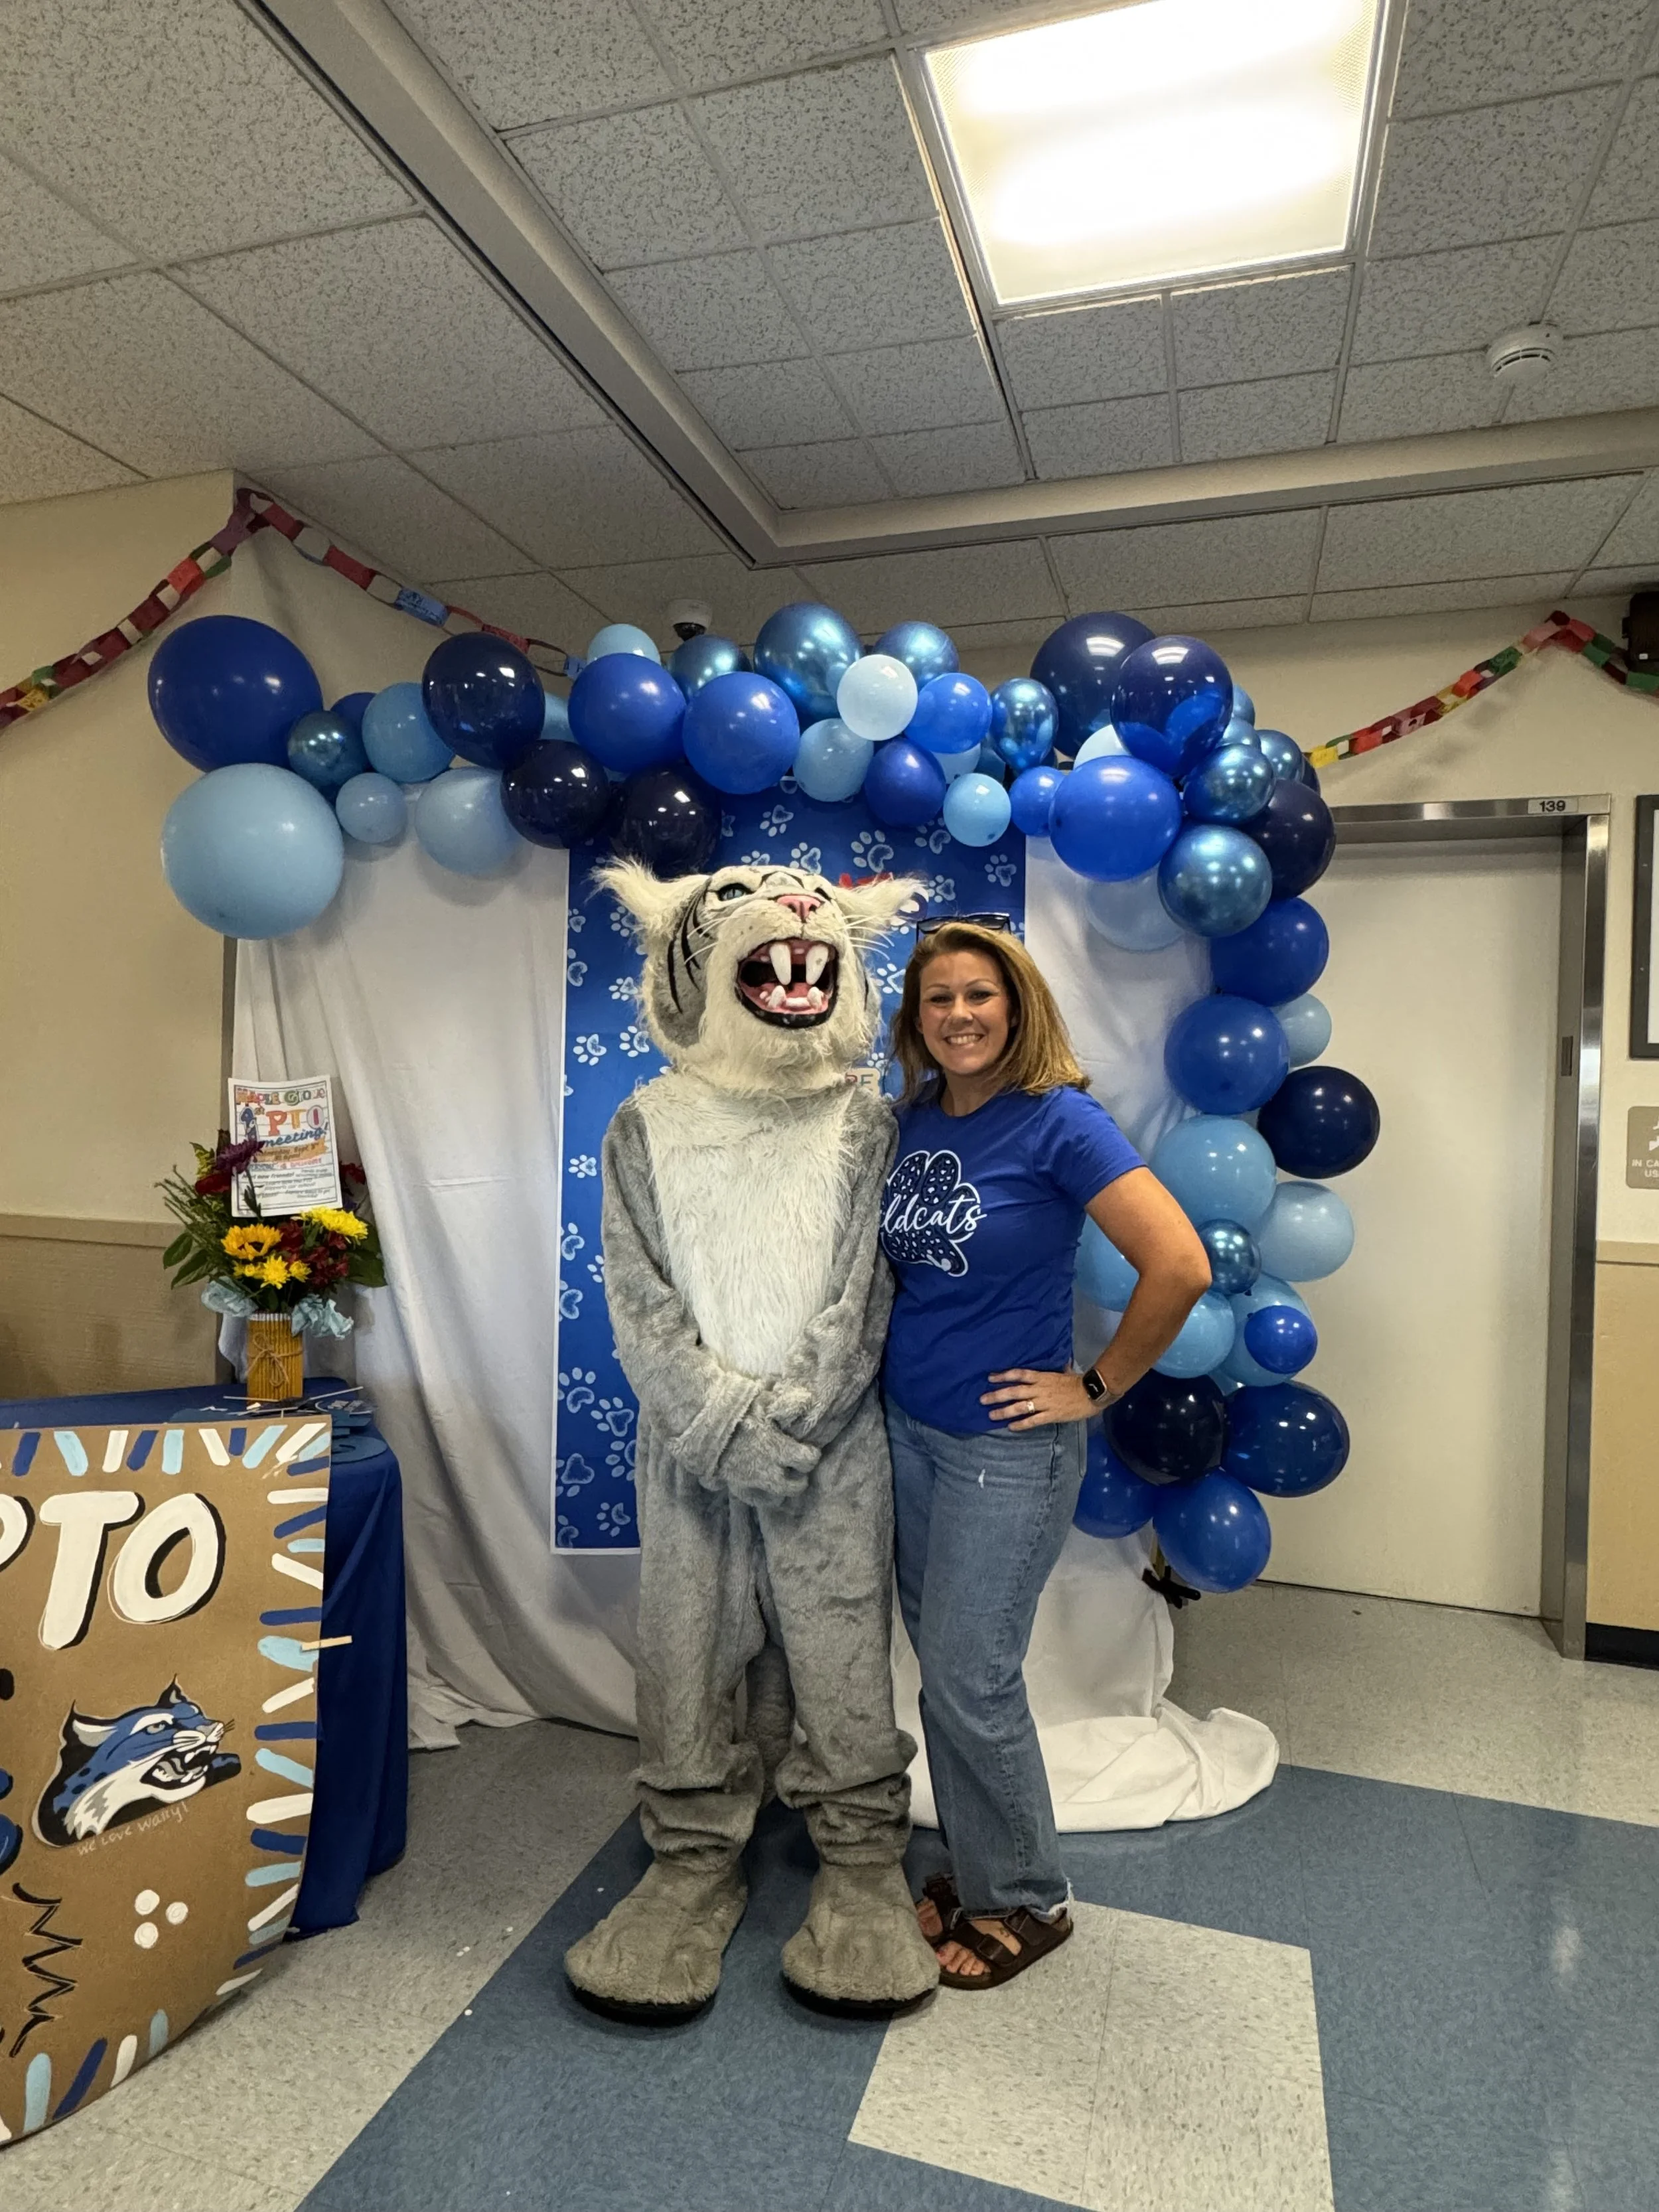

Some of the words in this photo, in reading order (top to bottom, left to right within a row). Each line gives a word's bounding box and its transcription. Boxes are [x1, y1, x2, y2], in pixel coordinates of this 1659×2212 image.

[1540, 800, 1565, 812] 139
[1644, 1169, 1659, 1177] US
[880, 1194, 987, 1234] ldcats
